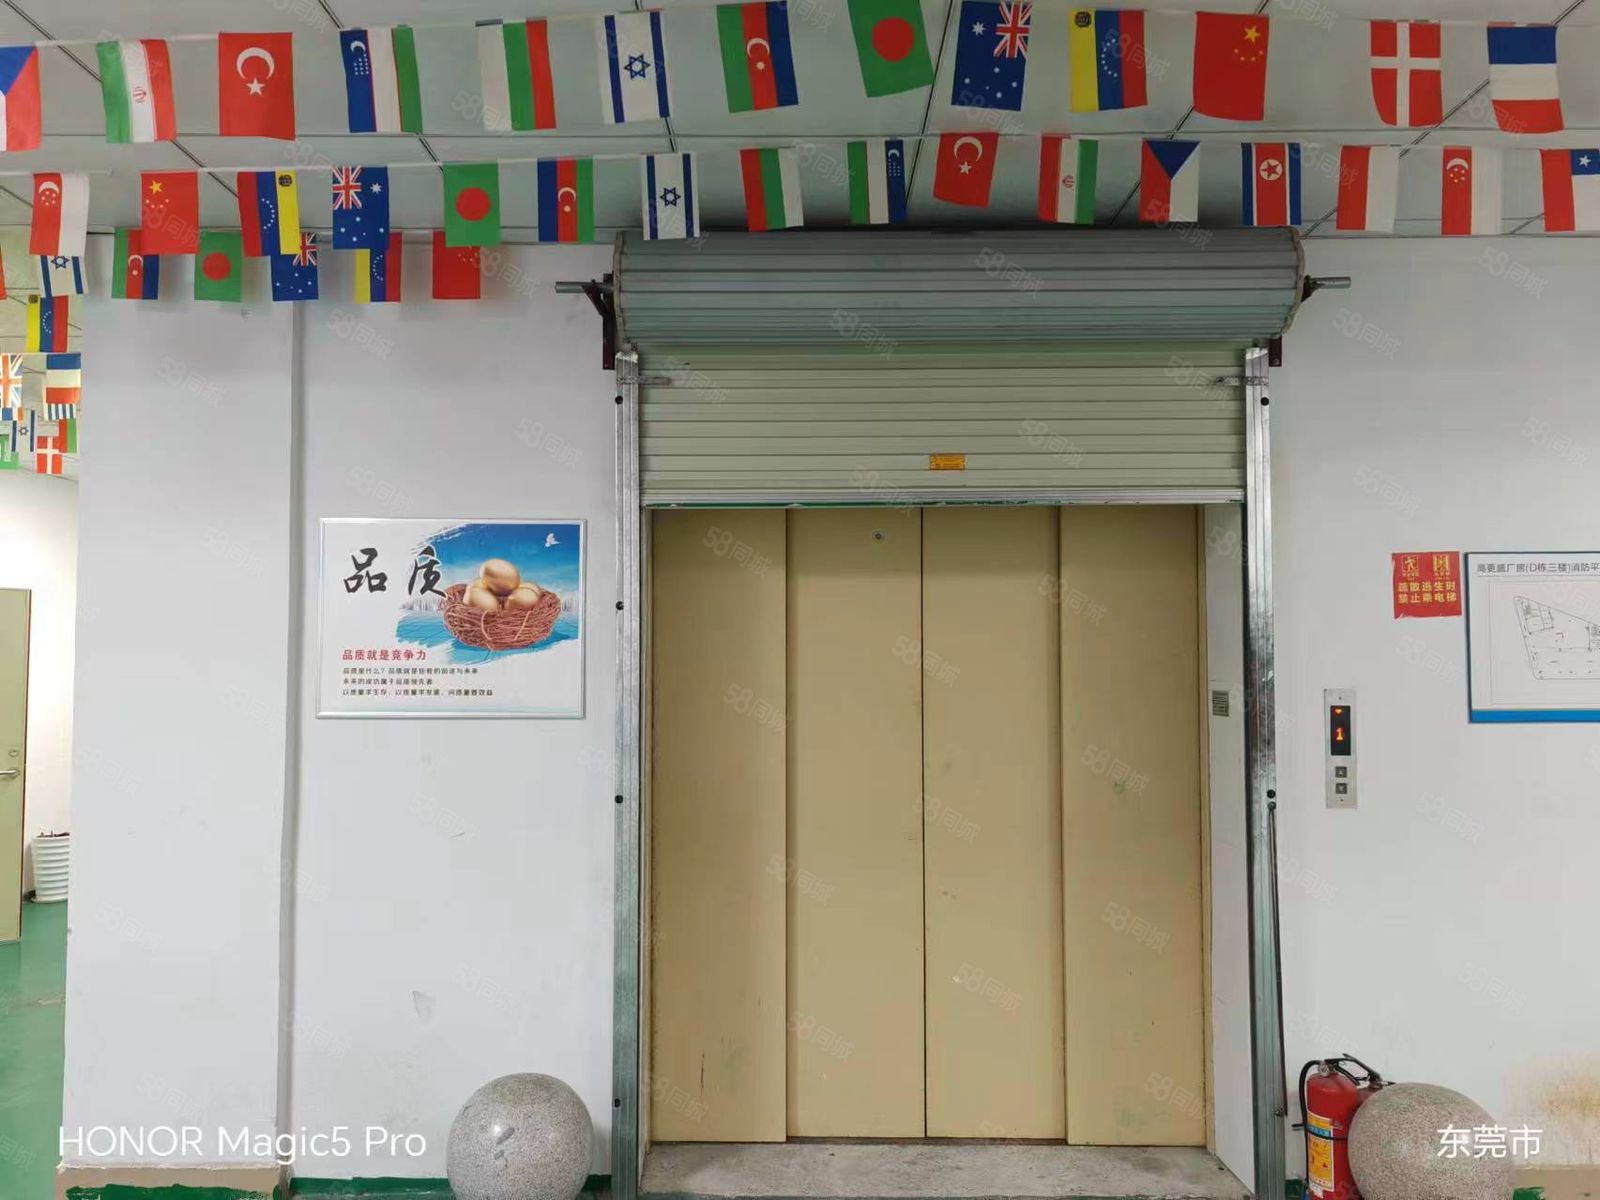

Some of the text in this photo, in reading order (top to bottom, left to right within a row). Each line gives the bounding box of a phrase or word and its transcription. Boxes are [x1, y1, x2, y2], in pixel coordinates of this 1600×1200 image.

[343, 545, 448, 598] 品质
[1398, 592, 1457, 604] 禁止乘电梯
[342, 649, 427, 661] 品质就是竞争力
[1336, 727, 1344, 740] 1
